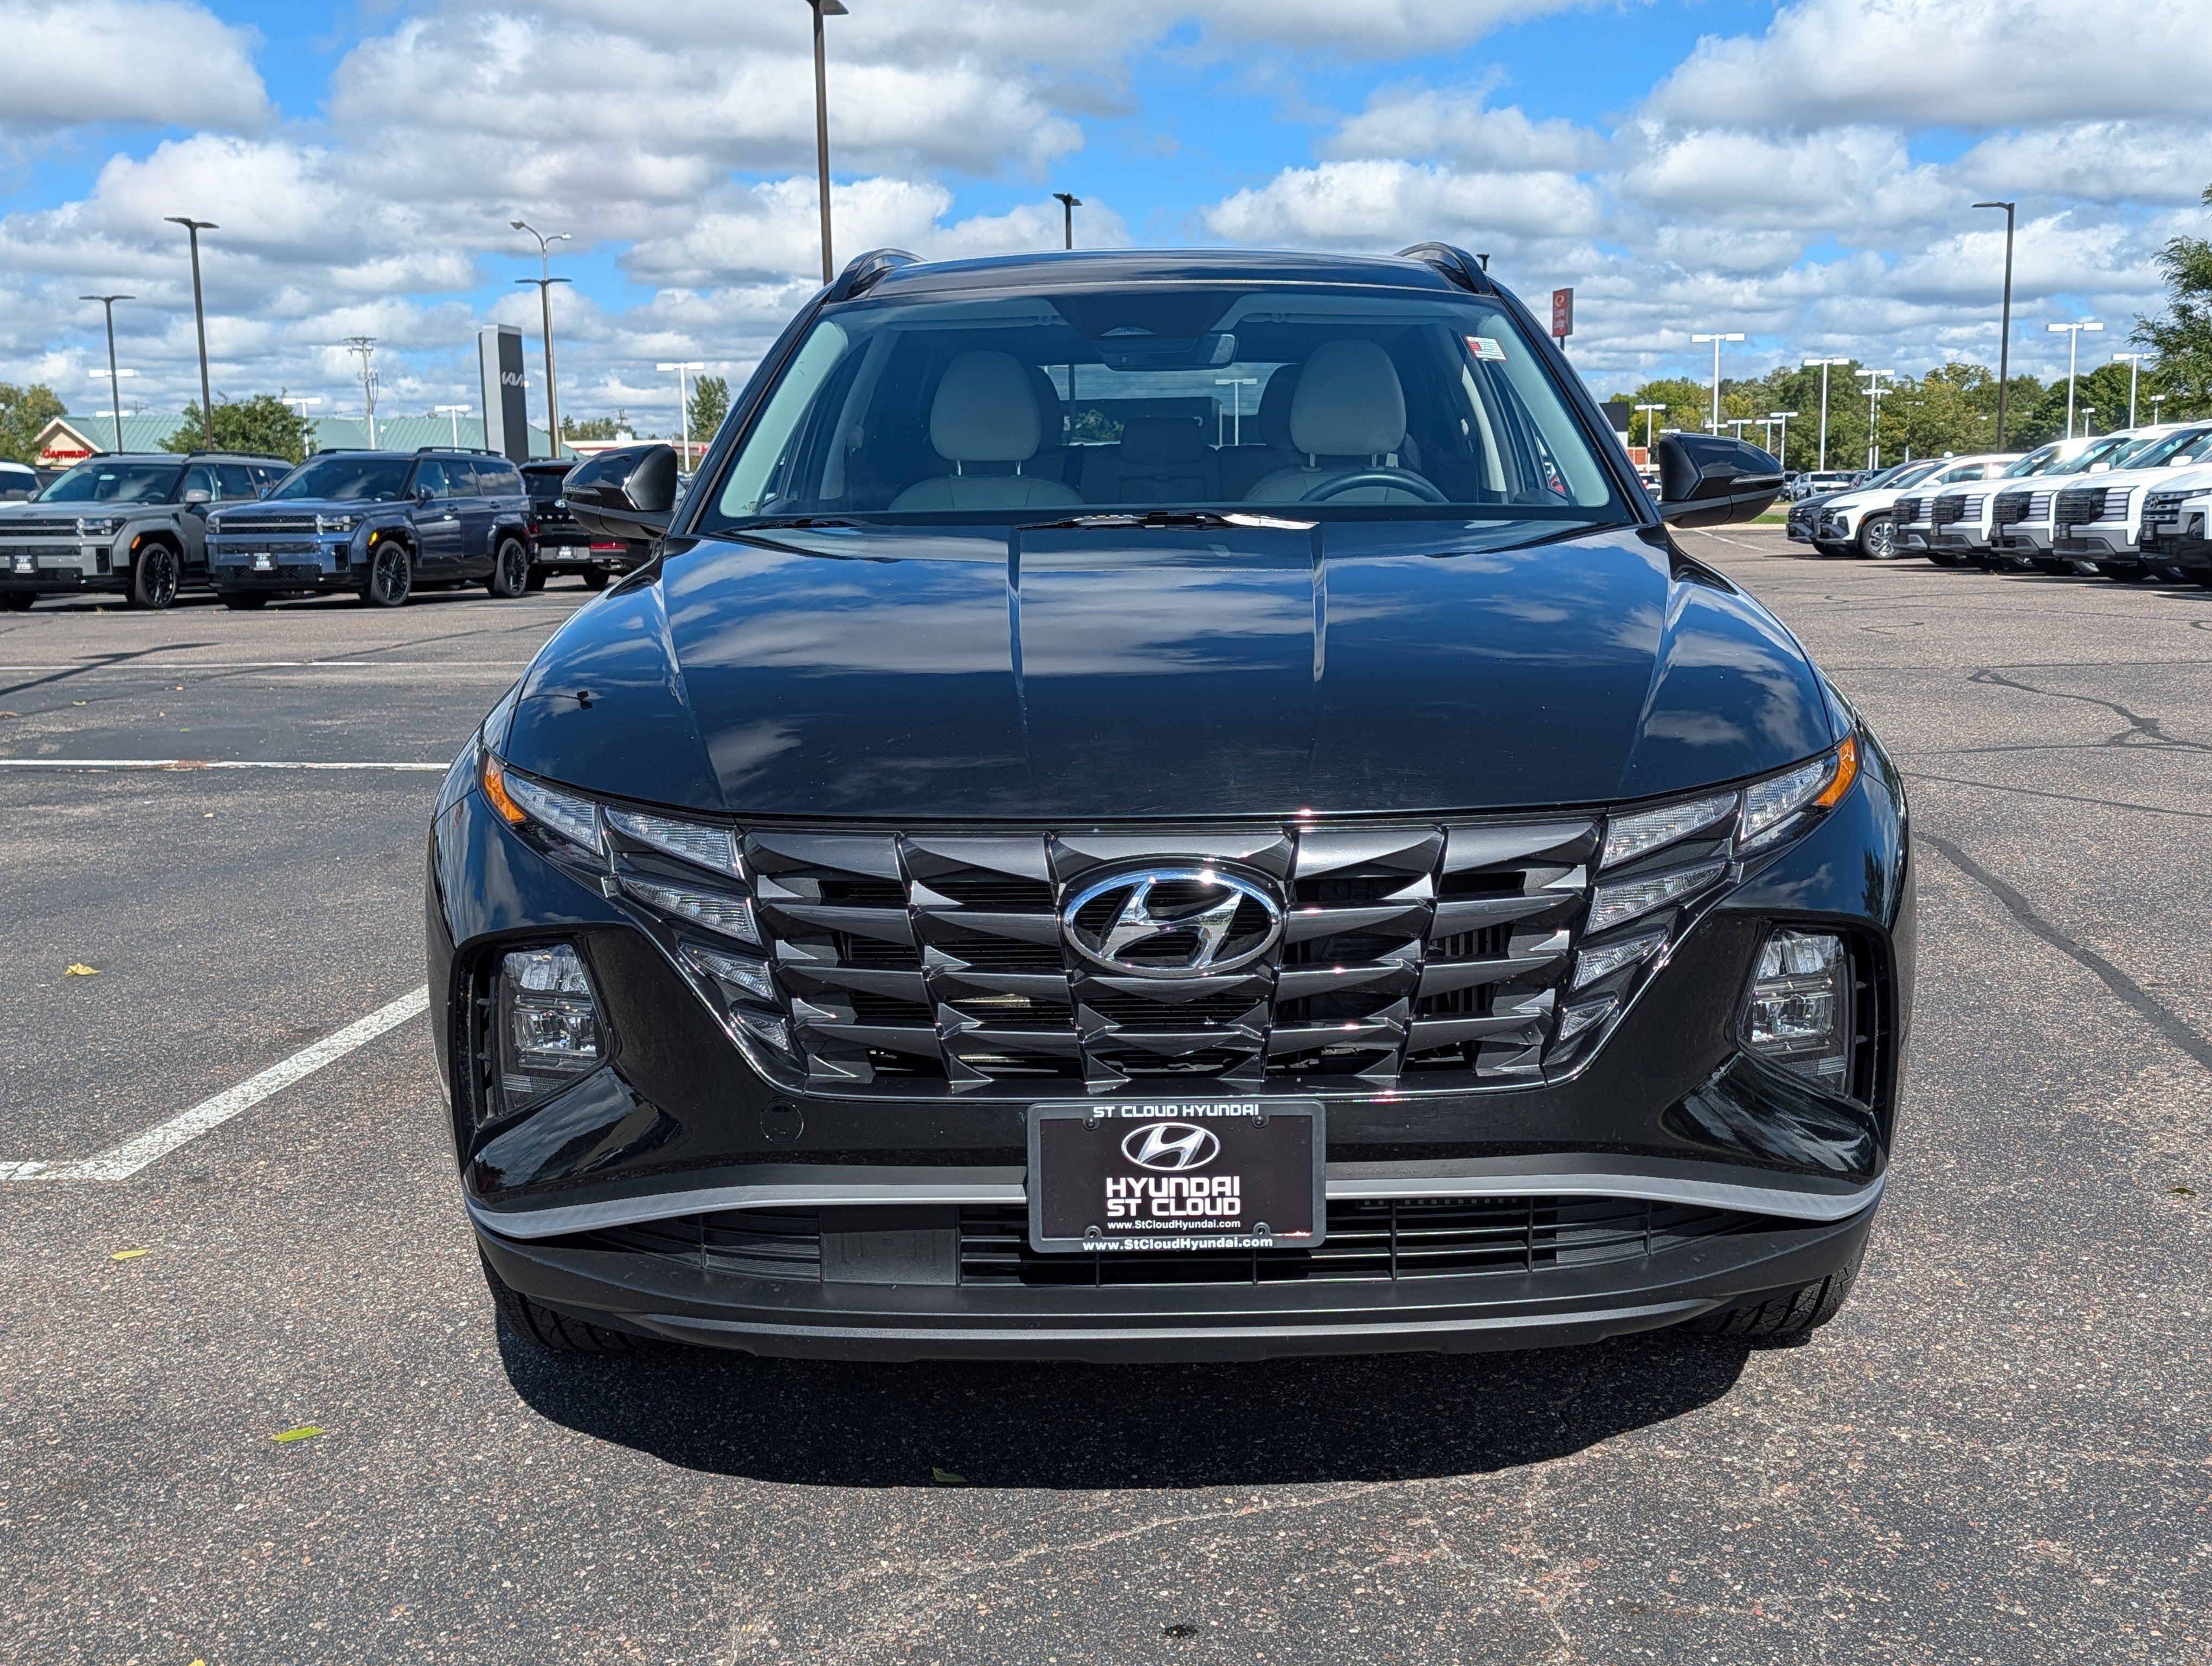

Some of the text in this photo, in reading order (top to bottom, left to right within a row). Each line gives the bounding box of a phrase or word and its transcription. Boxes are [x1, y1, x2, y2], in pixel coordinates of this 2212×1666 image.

[1093, 1104, 1259, 1118] ST CLOUD HYUNDAI
[1106, 1176, 1240, 1197] HYUNDAI
[1107, 1197, 1240, 1217] ST CLOUD
[1107, 1220, 1240, 1231] www.StCloudHyundai.com
[1082, 1236, 1274, 1251] www.StCloudHyundai.com
